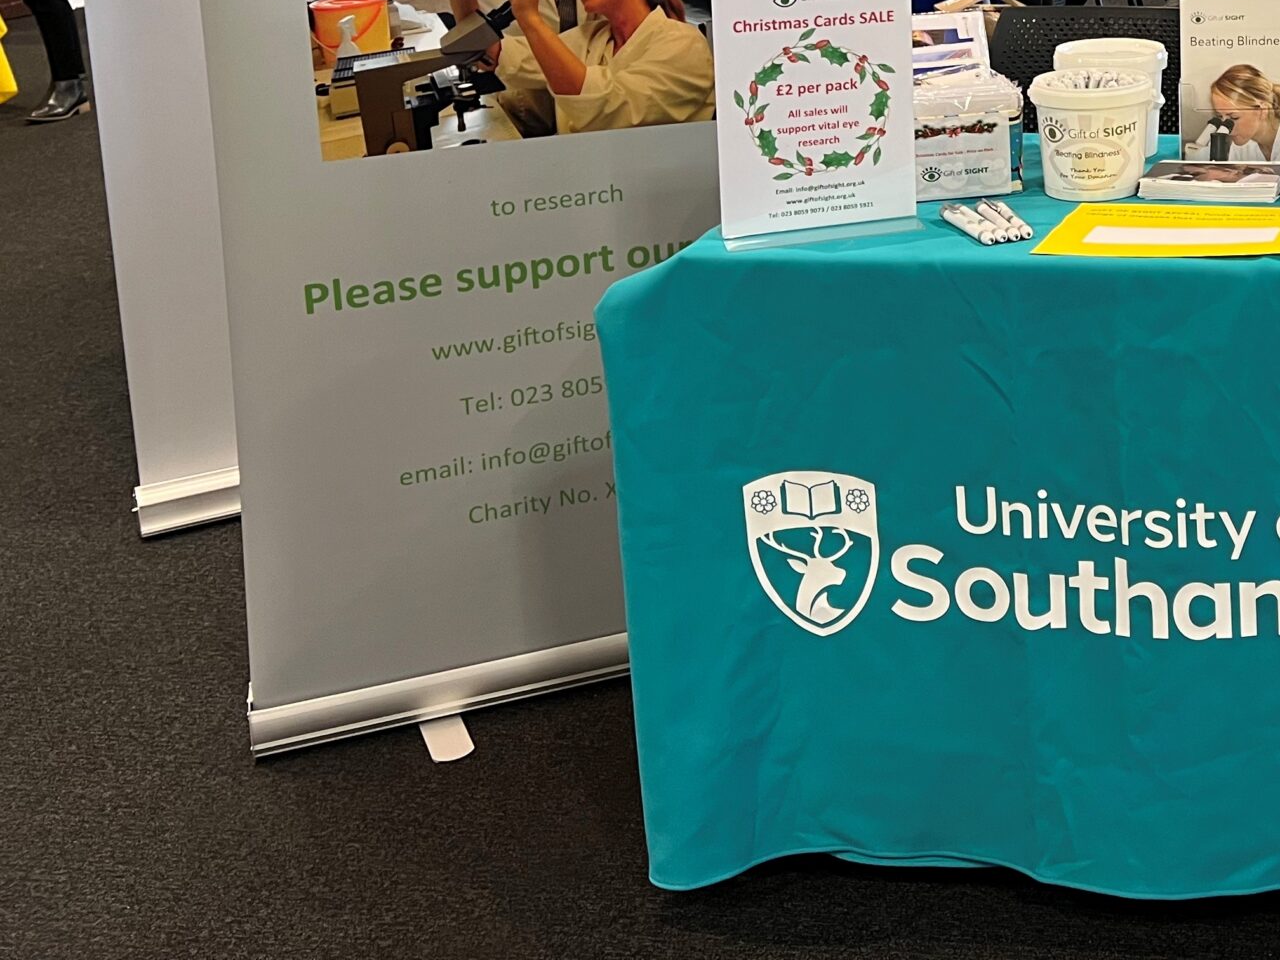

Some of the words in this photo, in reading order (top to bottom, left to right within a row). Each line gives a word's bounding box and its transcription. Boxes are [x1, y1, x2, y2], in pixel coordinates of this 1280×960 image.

[733, 17, 809, 33] Christmas
[814, 13, 855, 28] Cards
[859, 11, 895, 24] SALE
[1190, 36, 1233, 49] Beating
[776, 83, 793, 96] £2
[798, 83, 821, 97] per
[825, 78, 858, 95] pack
[788, 109, 800, 119] All
[803, 107, 828, 117] sales
[831, 105, 848, 115] will
[777, 124, 815, 136] support
[818, 121, 840, 131] vital
[843, 121, 860, 130] eye
[1068, 128, 1086, 139] Gift
[1089, 128, 1100, 139] of
[1103, 121, 1138, 137] SIGHT
[798, 135, 840, 147] research
[943, 169, 955, 177] Gift
[964, 167, 989, 175] SIGHT
[491, 196, 516, 218] to
[523, 185, 623, 214] research
[304, 268, 442, 314] Please
[457, 244, 615, 293] support
[461, 392, 503, 415] Tel:
[510, 383, 553, 407] 023
[400, 457, 474, 486] email:
[468, 490, 551, 524] Charity
[559, 486, 598, 507] No.
[955, 484, 1257, 561] University
